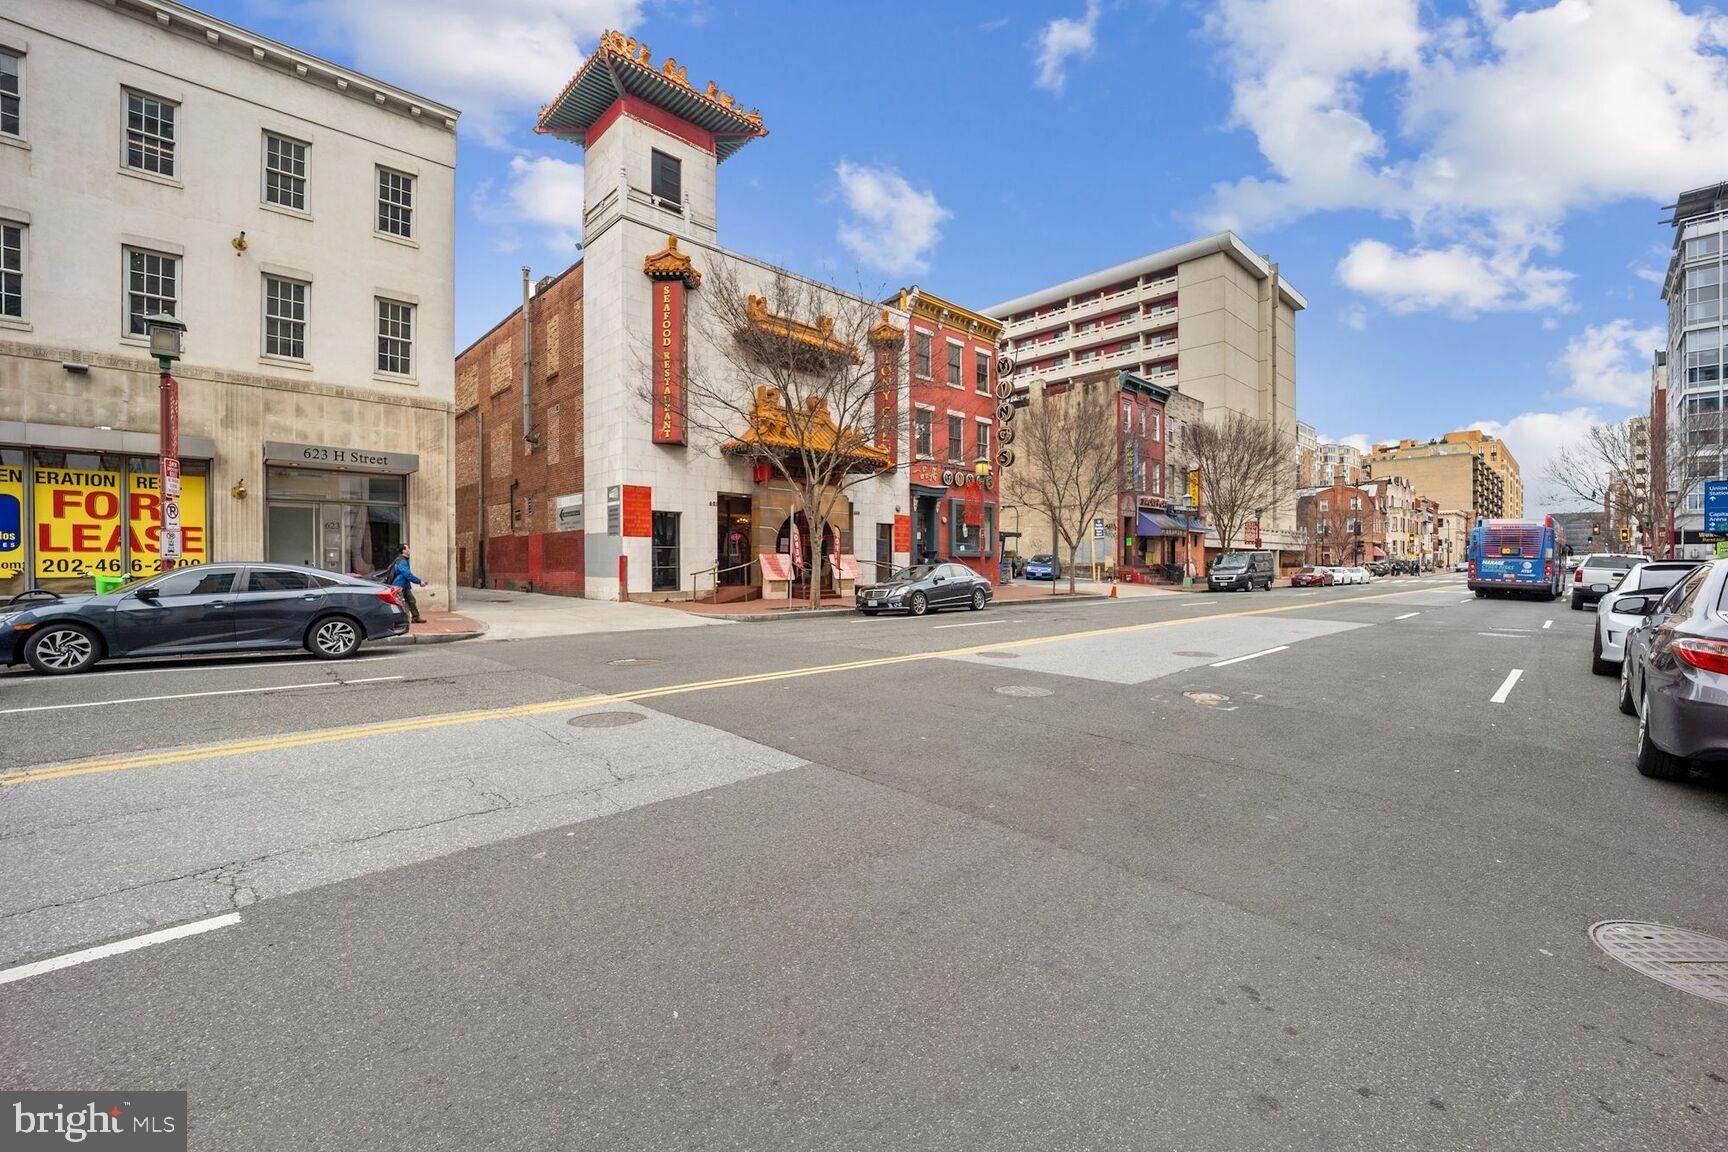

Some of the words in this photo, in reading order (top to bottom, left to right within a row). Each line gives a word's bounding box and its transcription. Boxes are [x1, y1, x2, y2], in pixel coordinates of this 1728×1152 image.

[662, 286, 671, 347] SEAFOOD
[663, 351, 671, 438] RESTAURANT
[303, 447, 328, 460] 623
[334, 450, 344, 462] H
[350, 452, 388, 466] Street
[53, 490, 161, 521] FOR
[39, 524, 204, 554] LEASE
[325, 521, 340, 530] 623
